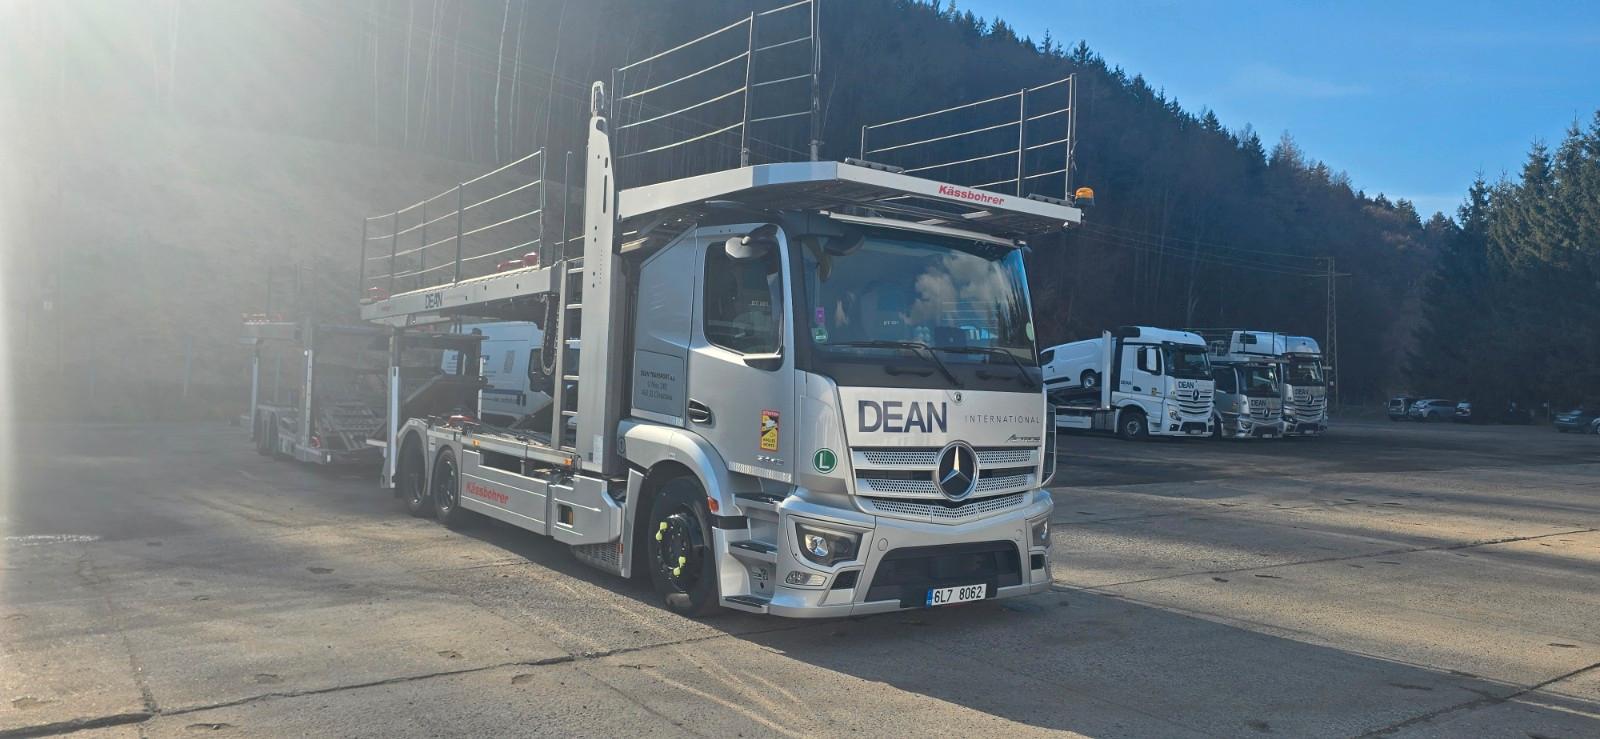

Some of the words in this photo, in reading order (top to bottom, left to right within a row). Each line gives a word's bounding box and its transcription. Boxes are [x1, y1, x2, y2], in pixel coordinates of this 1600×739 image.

[939, 185, 1004, 205] Kässbohrer
[425, 292, 443, 309] DEAN
[1178, 381, 1195, 389] DEAN
[1250, 399, 1267, 407] DEAN
[858, 399, 947, 433] DEAN
[964, 414, 1041, 424] INTERNATIONAL
[819, 452, 830, 469] L
[934, 589, 953, 603] 6L7
[959, 586, 982, 600] 8062
